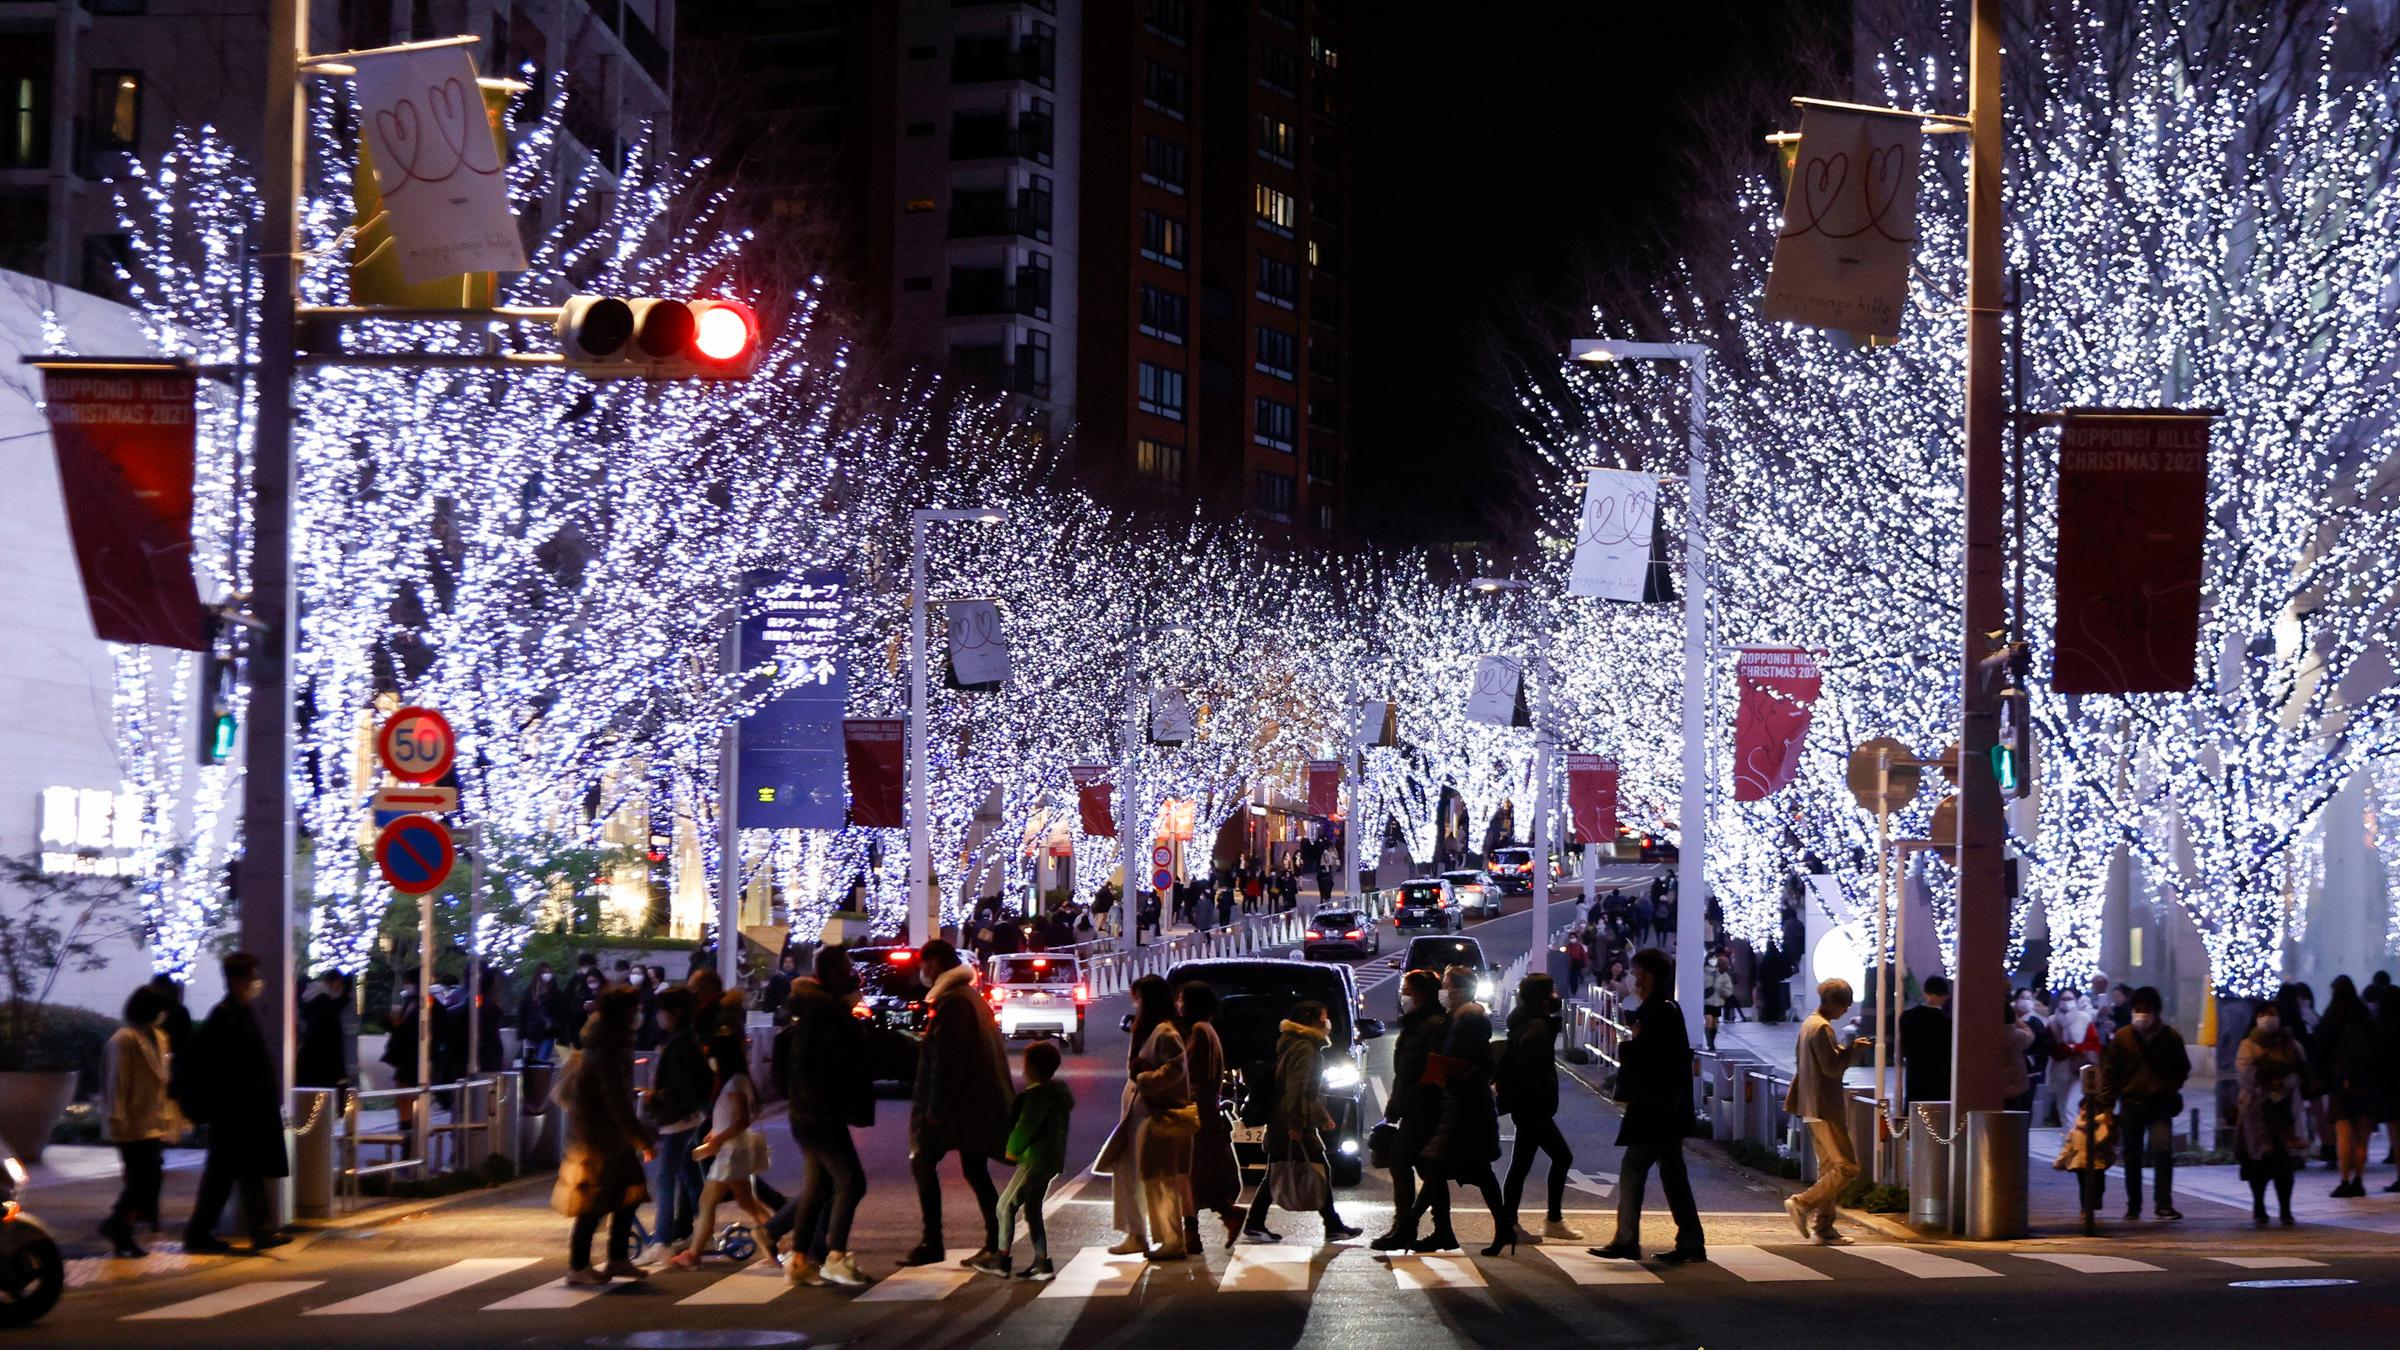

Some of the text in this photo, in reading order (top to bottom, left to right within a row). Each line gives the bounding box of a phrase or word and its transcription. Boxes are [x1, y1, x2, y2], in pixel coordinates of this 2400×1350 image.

[47, 378, 190, 400] ROPPONGI HILLS
[48, 403, 190, 424] CHRISTMAS 2021
[2065, 428, 2204, 449] ROPPONGI HILLS
[2065, 450, 2202, 472] CHRISTMAS 2021
[1741, 653, 1791, 665] ROPPONGI
[1741, 665, 1797, 678] CHRISTMAS
[395, 728, 438, 762] 50
